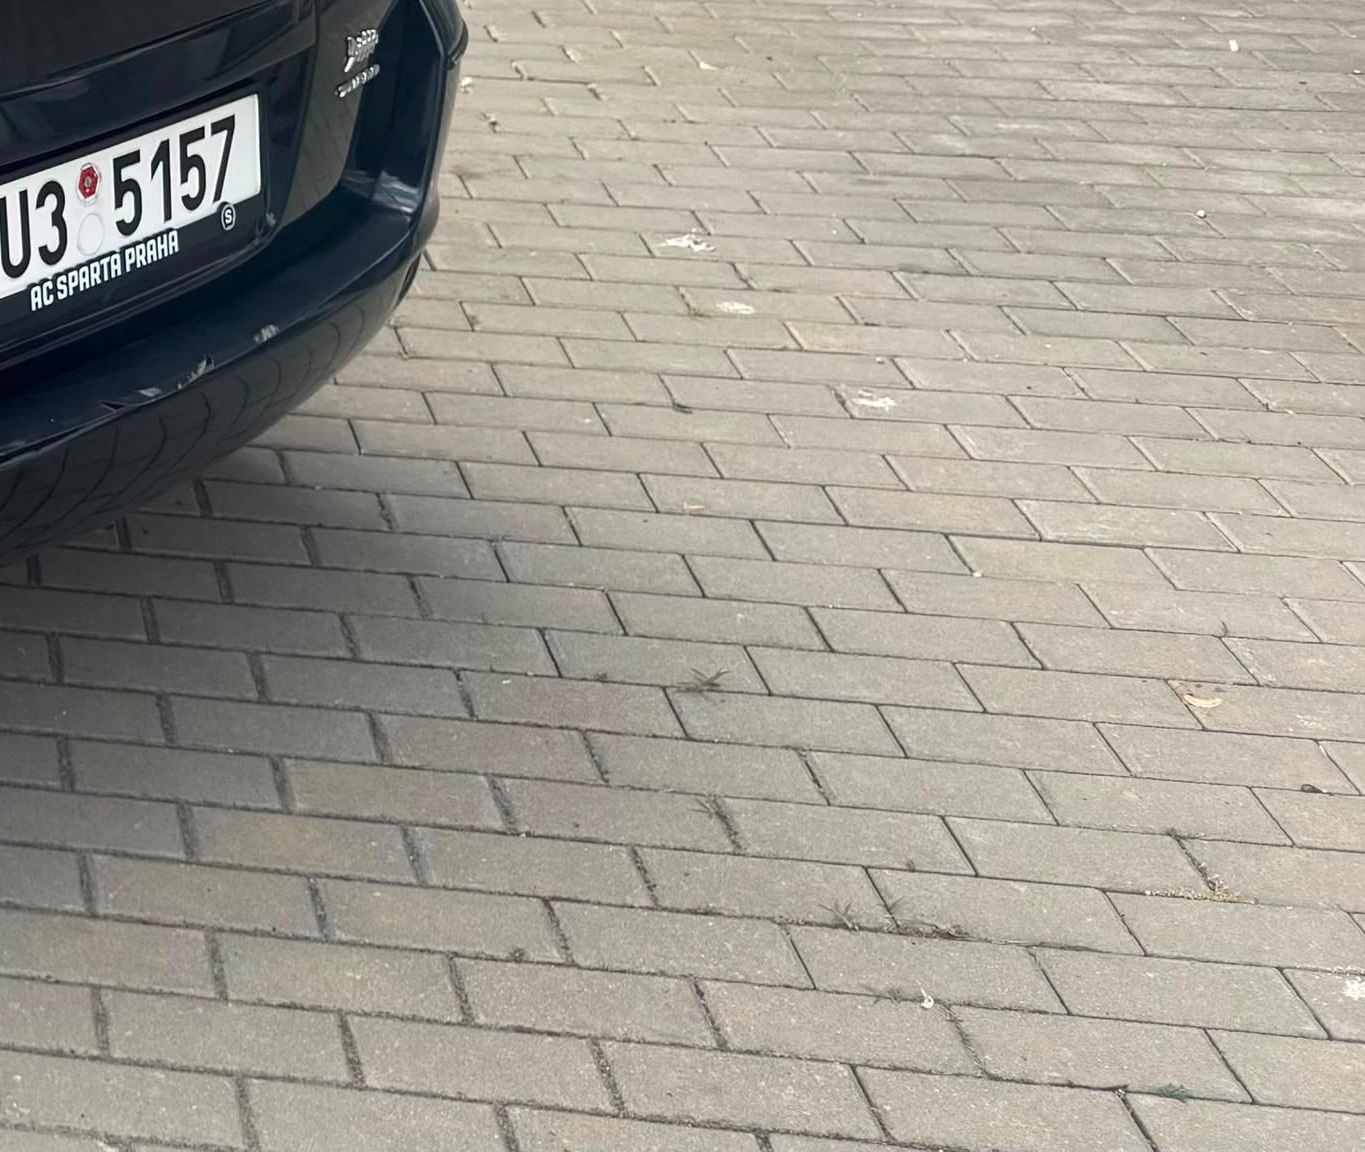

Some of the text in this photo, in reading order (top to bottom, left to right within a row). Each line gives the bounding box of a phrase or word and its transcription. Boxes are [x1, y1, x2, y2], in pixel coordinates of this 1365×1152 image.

[112, 114, 236, 237] 5157
[31, 229, 180, 312] AC SPARTA PRAHA
